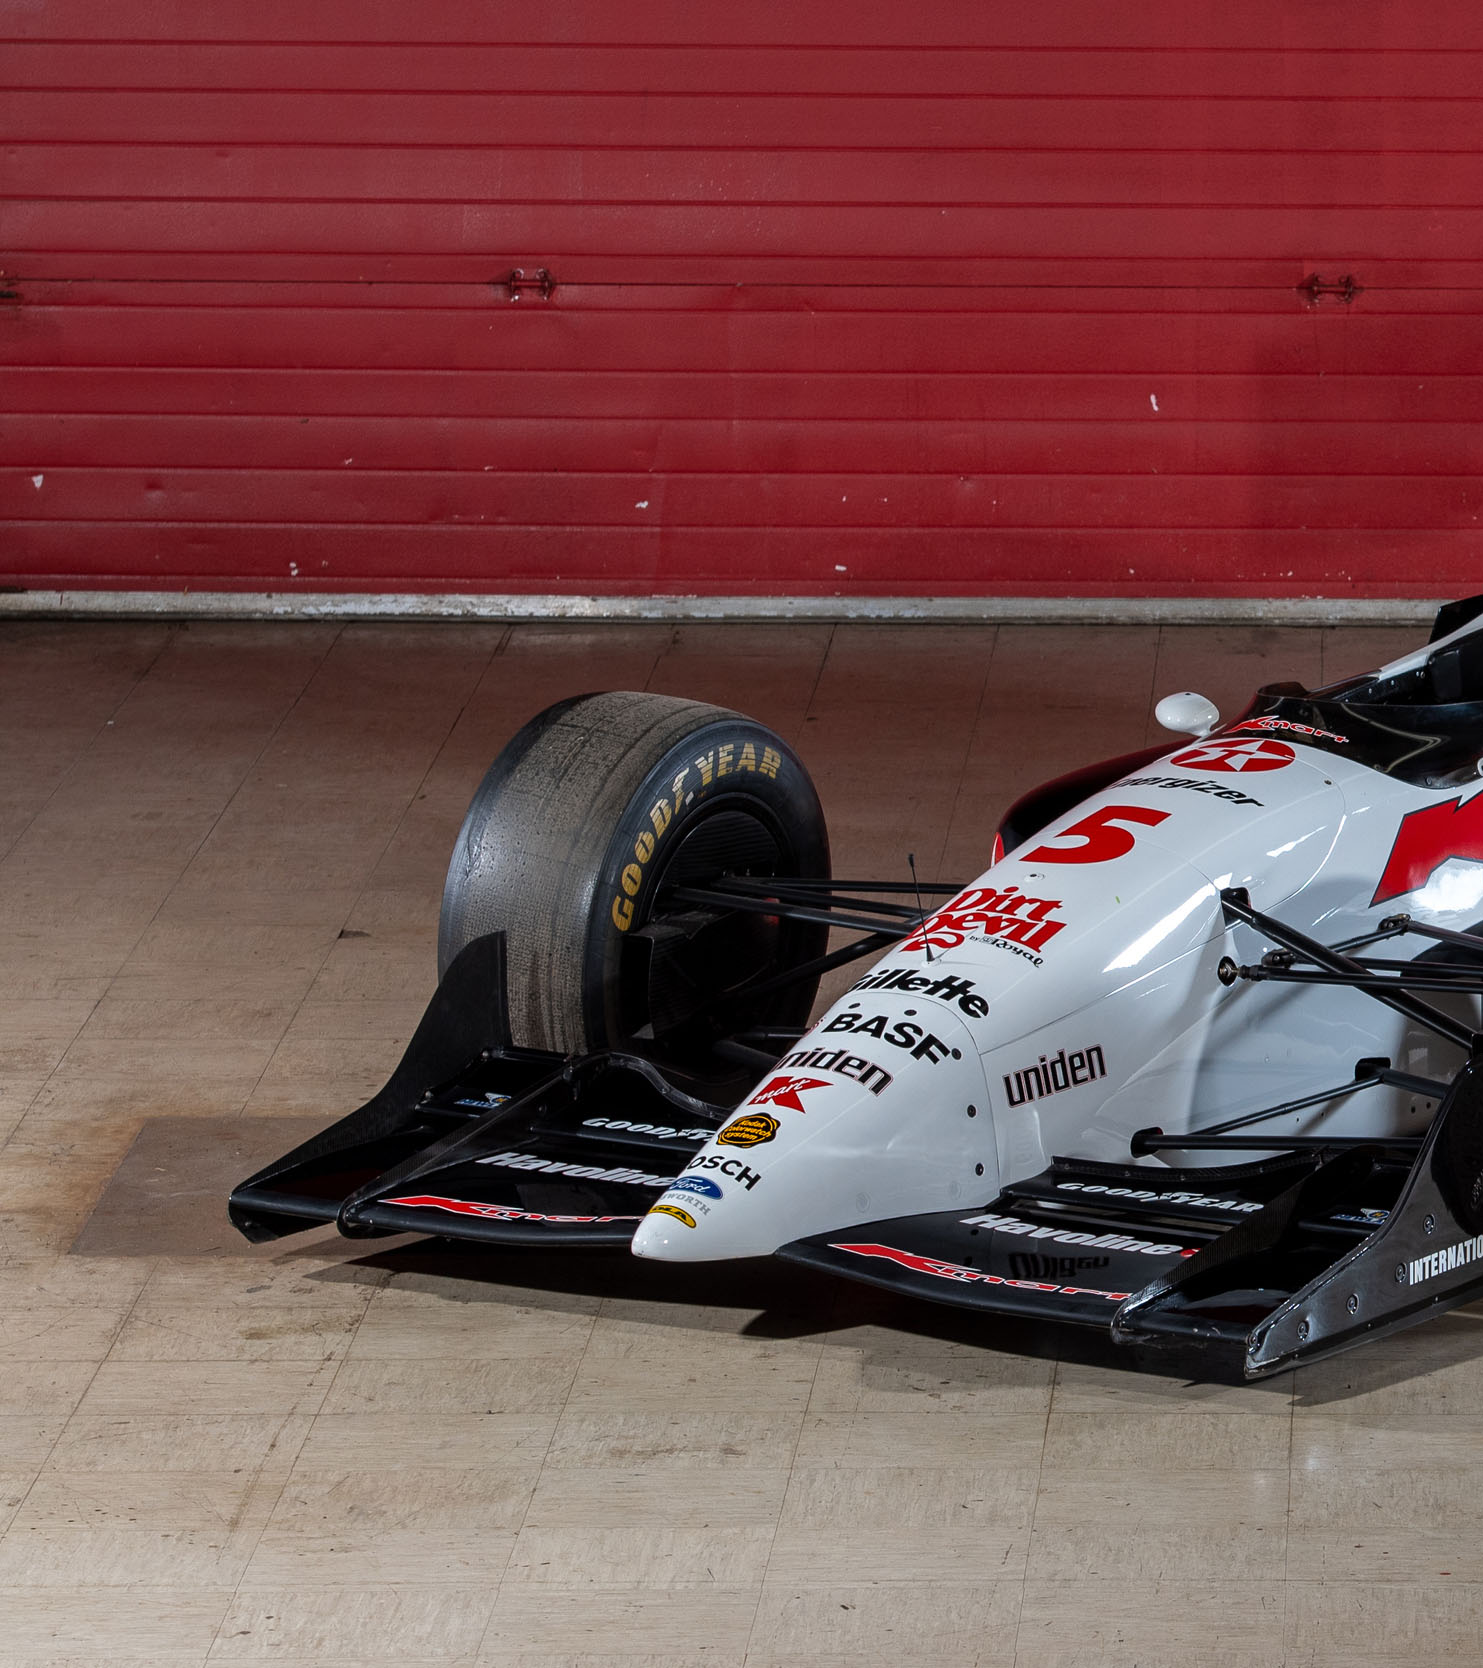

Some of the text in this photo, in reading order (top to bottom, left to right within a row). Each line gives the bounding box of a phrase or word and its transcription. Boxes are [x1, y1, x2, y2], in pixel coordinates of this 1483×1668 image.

[1222, 715, 1350, 743] Kmart
[611, 743, 782, 931] GOODYEAR
[1018, 805, 1173, 864] 5
[936, 886, 1064, 922] Dirt
[903, 912, 1068, 953] Devil
[991, 939, 1044, 968] Royal
[820, 1013, 950, 1065] BASF
[1002, 1043, 1108, 1109] uniden
[724, 1131, 758, 1140] system
[738, 1119, 767, 1129] Kodak
[475, 1152, 677, 1187] Havoline
[688, 1156, 762, 1191] OSCH
[379, 1195, 646, 1222] Kmar
[1057, 1183, 1265, 1214] GOODYEAR
[959, 1214, 1184, 1256] Havoline
[827, 1243, 1135, 1300] Kmart
